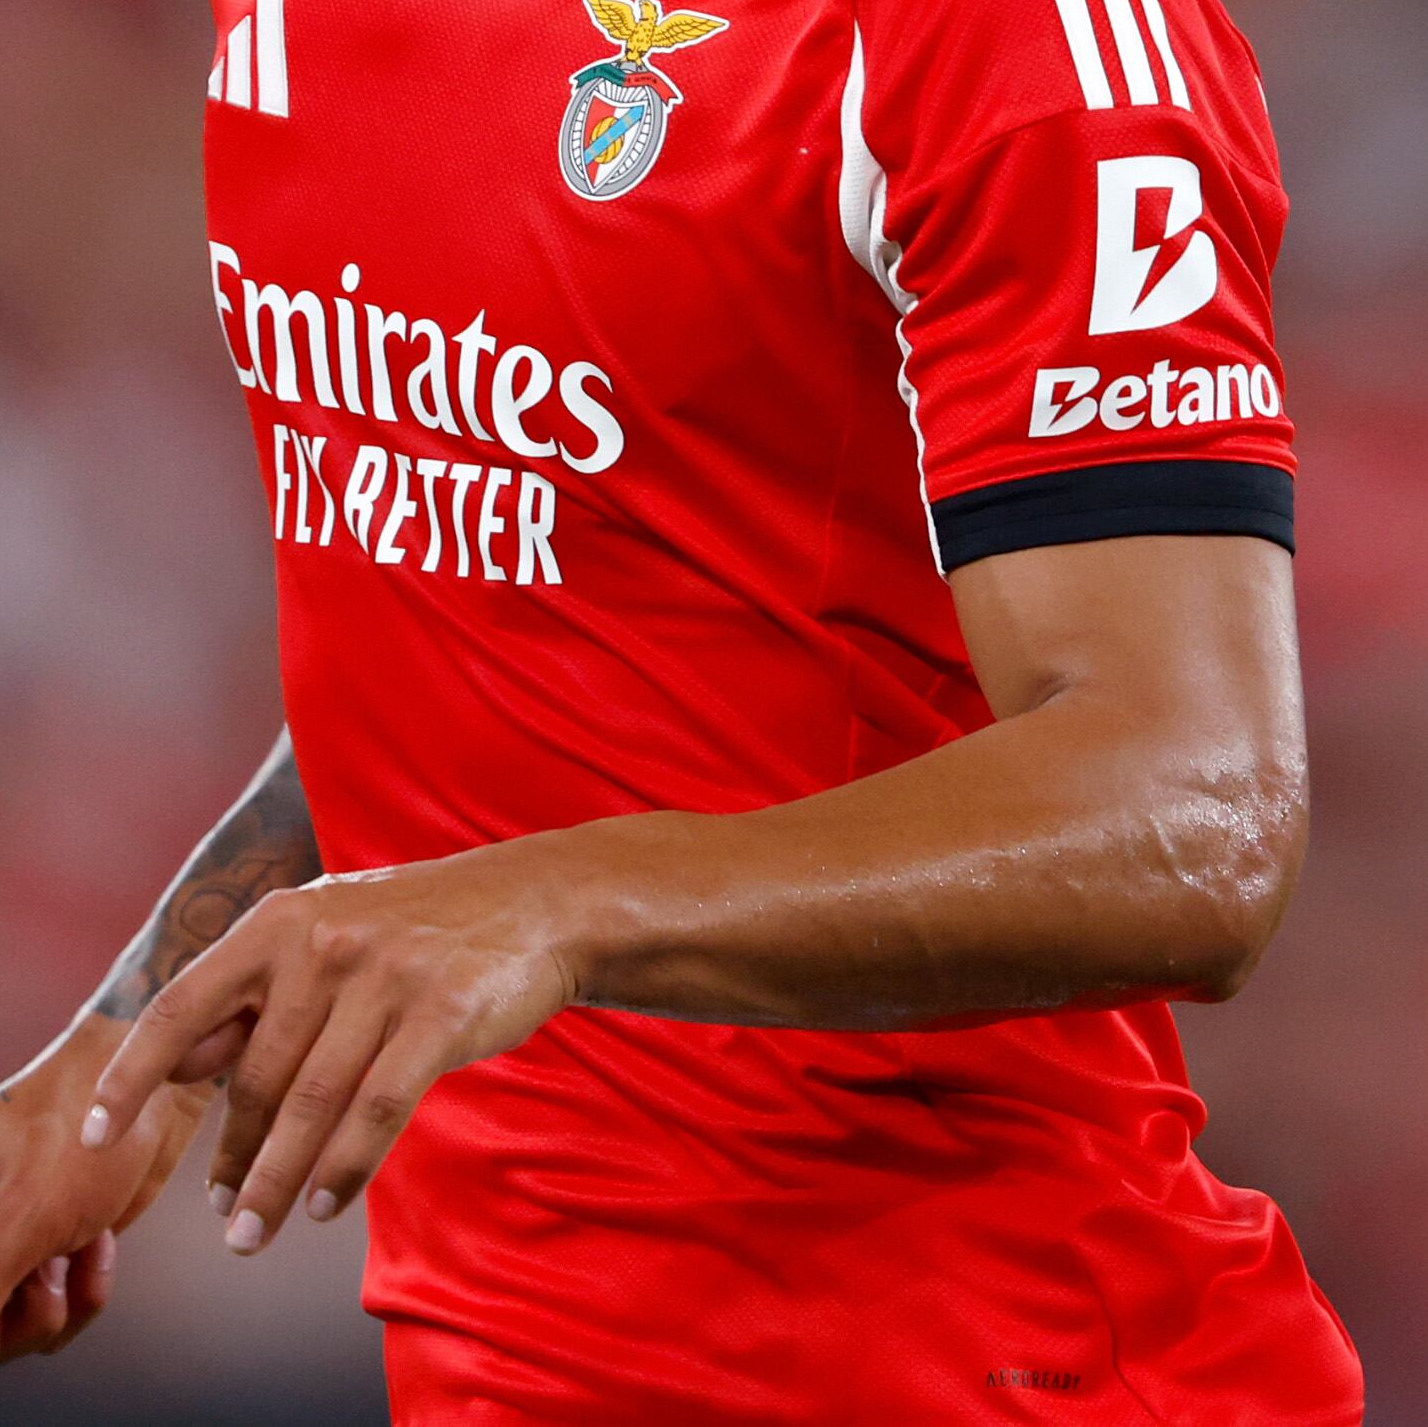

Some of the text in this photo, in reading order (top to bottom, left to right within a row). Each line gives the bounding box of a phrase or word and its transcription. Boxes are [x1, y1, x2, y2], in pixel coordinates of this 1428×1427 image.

[1088, 155, 1218, 336] B
[209, 240, 625, 474] Emirates
[1028, 358, 1280, 438] Betano
[273, 424, 335, 547] FLY
